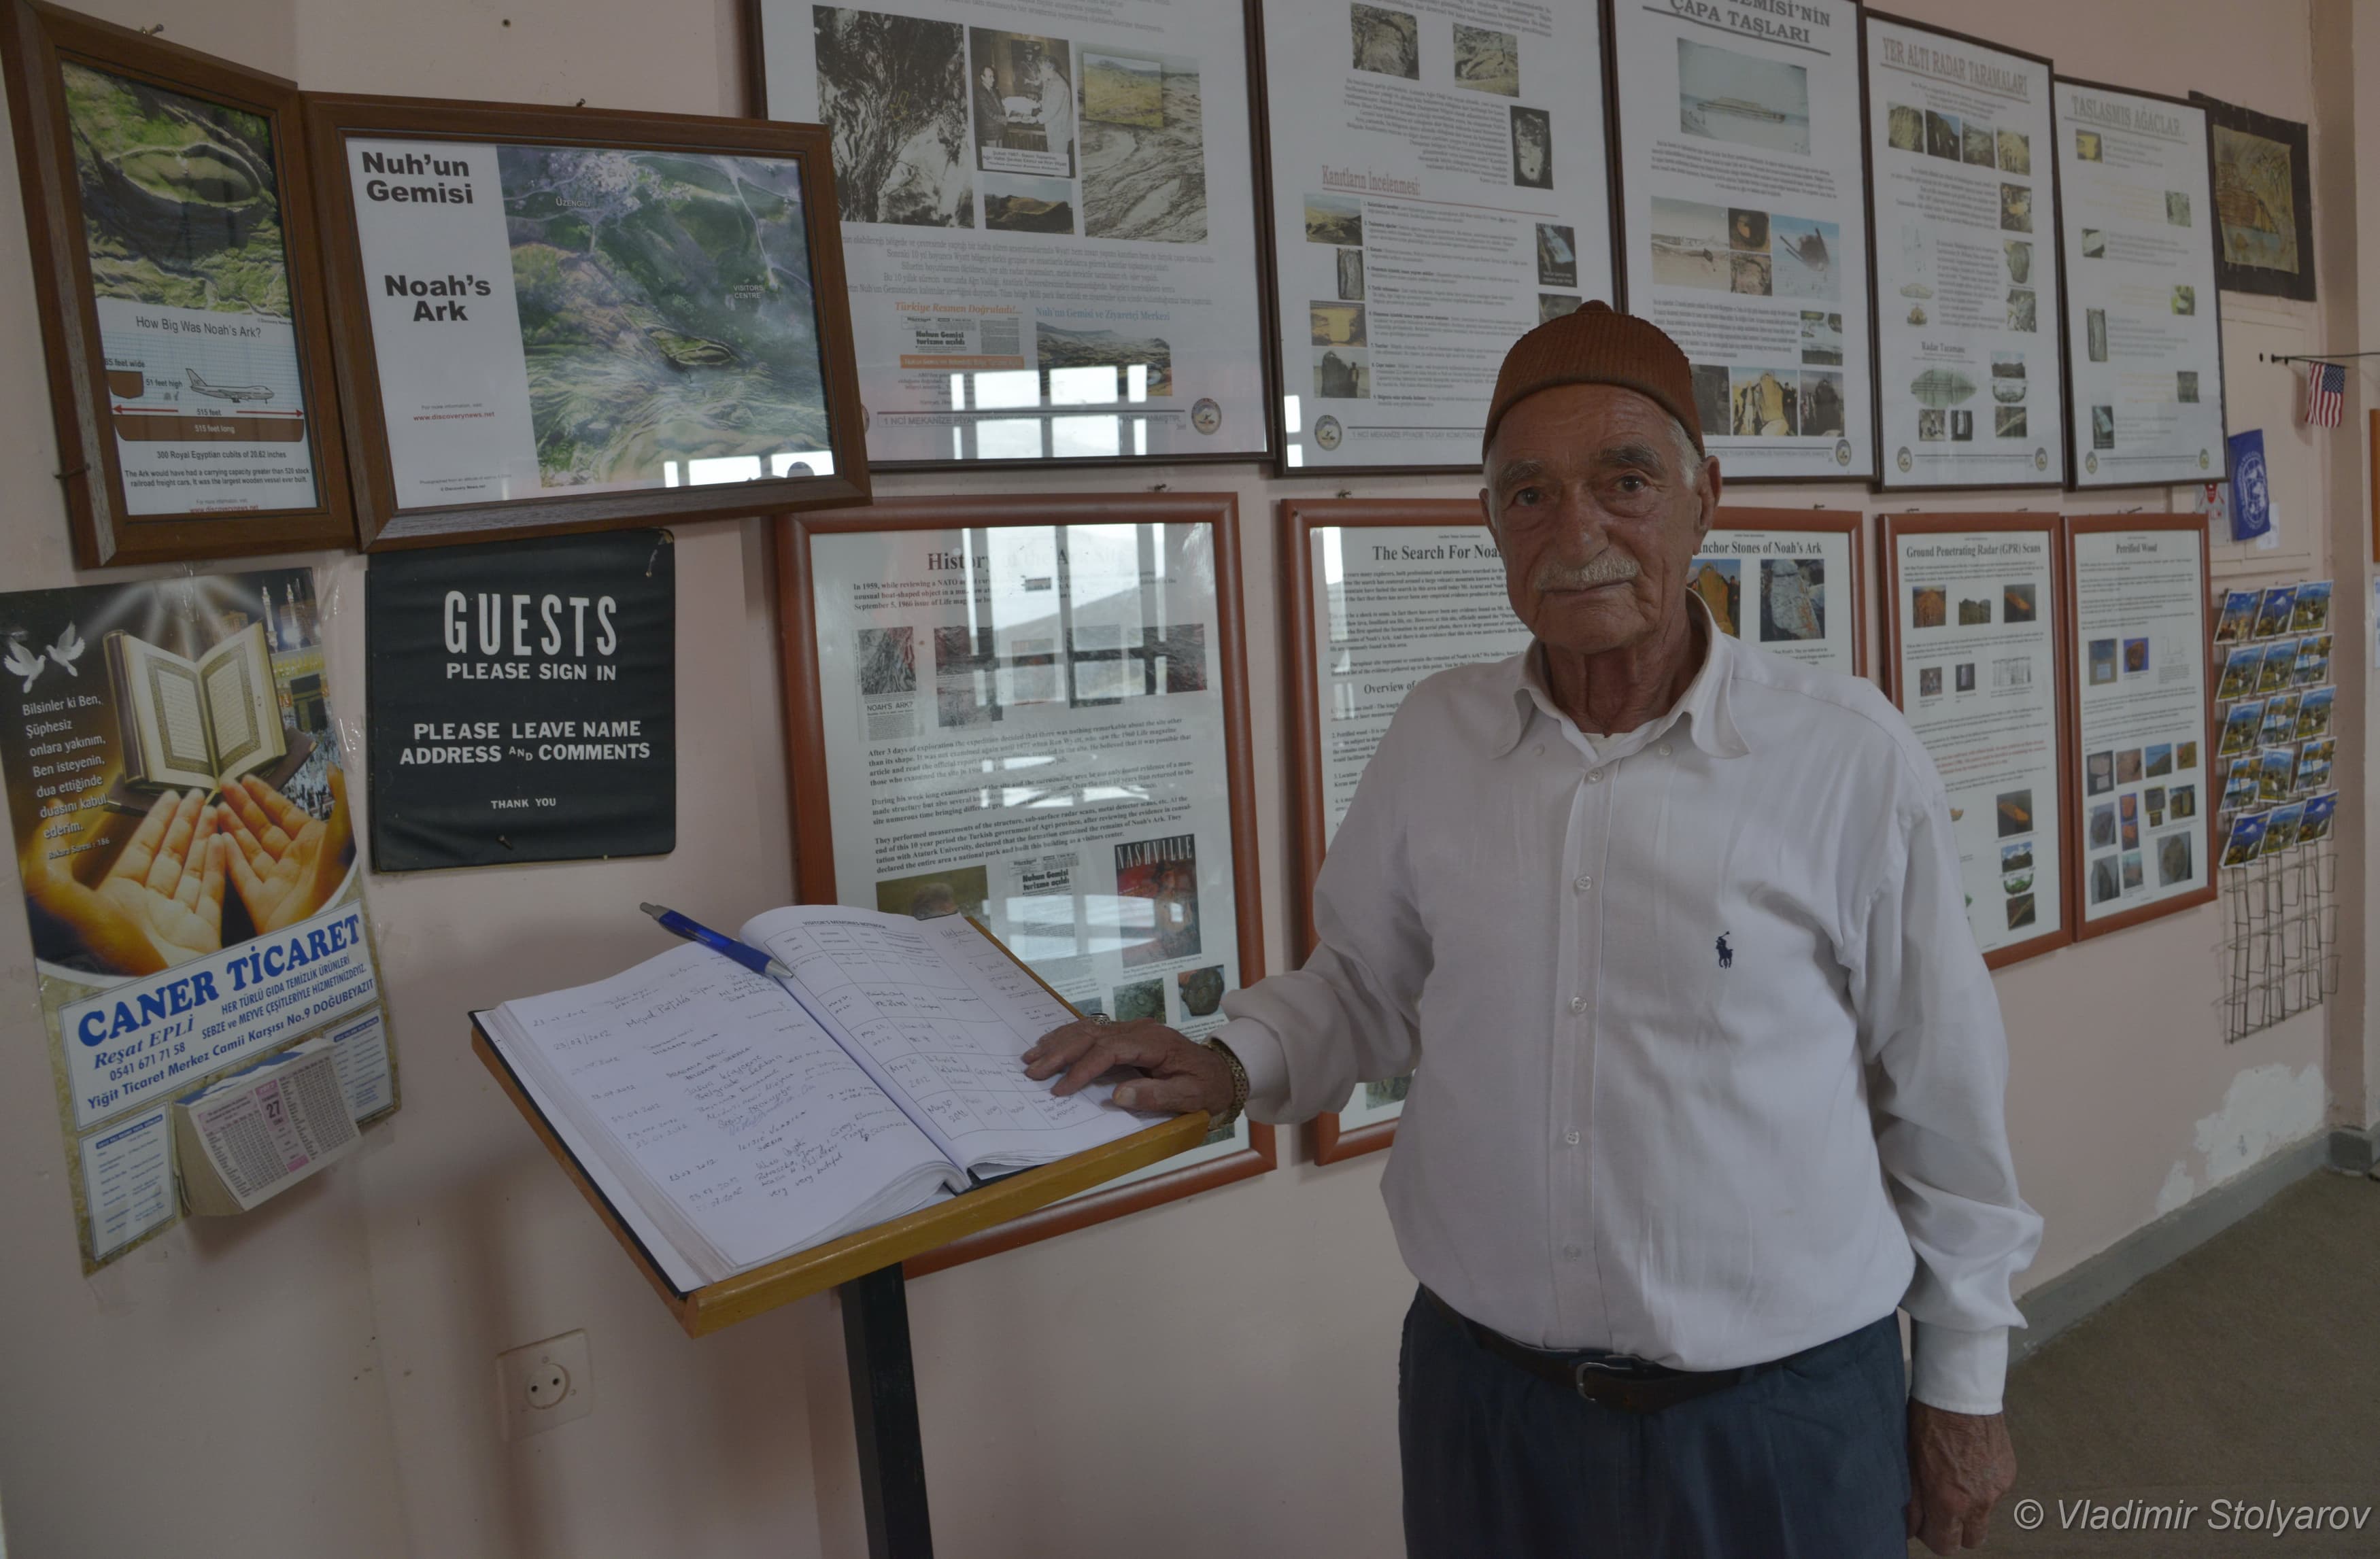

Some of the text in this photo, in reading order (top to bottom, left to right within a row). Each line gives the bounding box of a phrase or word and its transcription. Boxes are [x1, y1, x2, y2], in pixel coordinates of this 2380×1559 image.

[1727, 10, 1811, 43] TAŞLARI
[1883, 37, 2028, 95] YER ALTI RADAR TARAMALARI
[363, 152, 469, 176] Nuh'un
[1322, 165, 1366, 190] Kanıtların
[367, 179, 473, 203] Gemisi
[385, 275, 491, 296] Noah's
[413, 301, 468, 321] Ark
[895, 301, 930, 313] Türkiye
[932, 303, 966, 313] Resmen
[136, 315, 260, 337] How Big Was Noah's Ark?
[114, 359, 129, 367] feet
[129, 360, 145, 368] wide
[146, 378, 153, 388] 51
[169, 379, 182, 389] high
[197, 408, 222, 416] 515 feet
[413, 411, 494, 422] www.discoverynews.net
[207, 424, 220, 433] feet
[220, 425, 235, 434] long
[170, 451, 190, 460] Royal
[190, 450, 220, 460] Egyptian
[1372, 544, 1500, 560] The Search For Noa
[1699, 541, 1821, 553] nchor Stones of Noah's Ark
[1906, 543, 2041, 558] Ground Penetrating Radar (GPR) Scans
[937, 579, 957, 587] NATO
[444, 590, 617, 657] GUESTS
[446, 662, 617, 681] PLEASE SIGN IN
[1363, 681, 1415, 694] Overview of
[23, 696, 101, 716] Bilsinler ki Ben,
[867, 703, 892, 711] NOAH'S
[27, 719, 72, 739] Şüphesiz
[414, 721, 641, 741] PLEASE LEAVE NAME
[30, 736, 105, 756] onlara yakınım,
[400, 742, 650, 765] ADDRESS AND COMMENTS
[33, 755, 105, 777] Ben isteyenin,
[37, 774, 102, 798] dua ettiğinde
[41, 793, 106, 817] duasını kabul
[491, 798, 556, 809] THANK YOU
[44, 821, 84, 838] ederim.
[892, 831, 926, 843] performed
[928, 825, 973, 836] measurements
[993, 819, 1023, 827] structure,
[97, 838, 109, 848] 186
[1117, 836, 1192, 870] NASHVILLE
[1023, 871, 1068, 883] Nuhun Gemisi
[78, 913, 359, 1046] CANER TİCARET
[222, 955, 350, 1014] HER TÜRLÜ GIDA TEMİZLİK ÜRÜNLERİ
[202, 1021, 226, 1039] SEBZE
[227, 1020, 237, 1028] ve
[239, 1006, 264, 1025] MEYVE
[88, 977, 373, 1109] Yiğit Ticaret Merkez Camii Karşısı No.9 DOĞUBEYAZIT
[94, 1013, 194, 1069] Reşat EPLİ
[109, 1042, 185, 1080] 0541 671 71 58
[889, 1061, 909, 1075] May
[266, 1099, 281, 1118] 27
